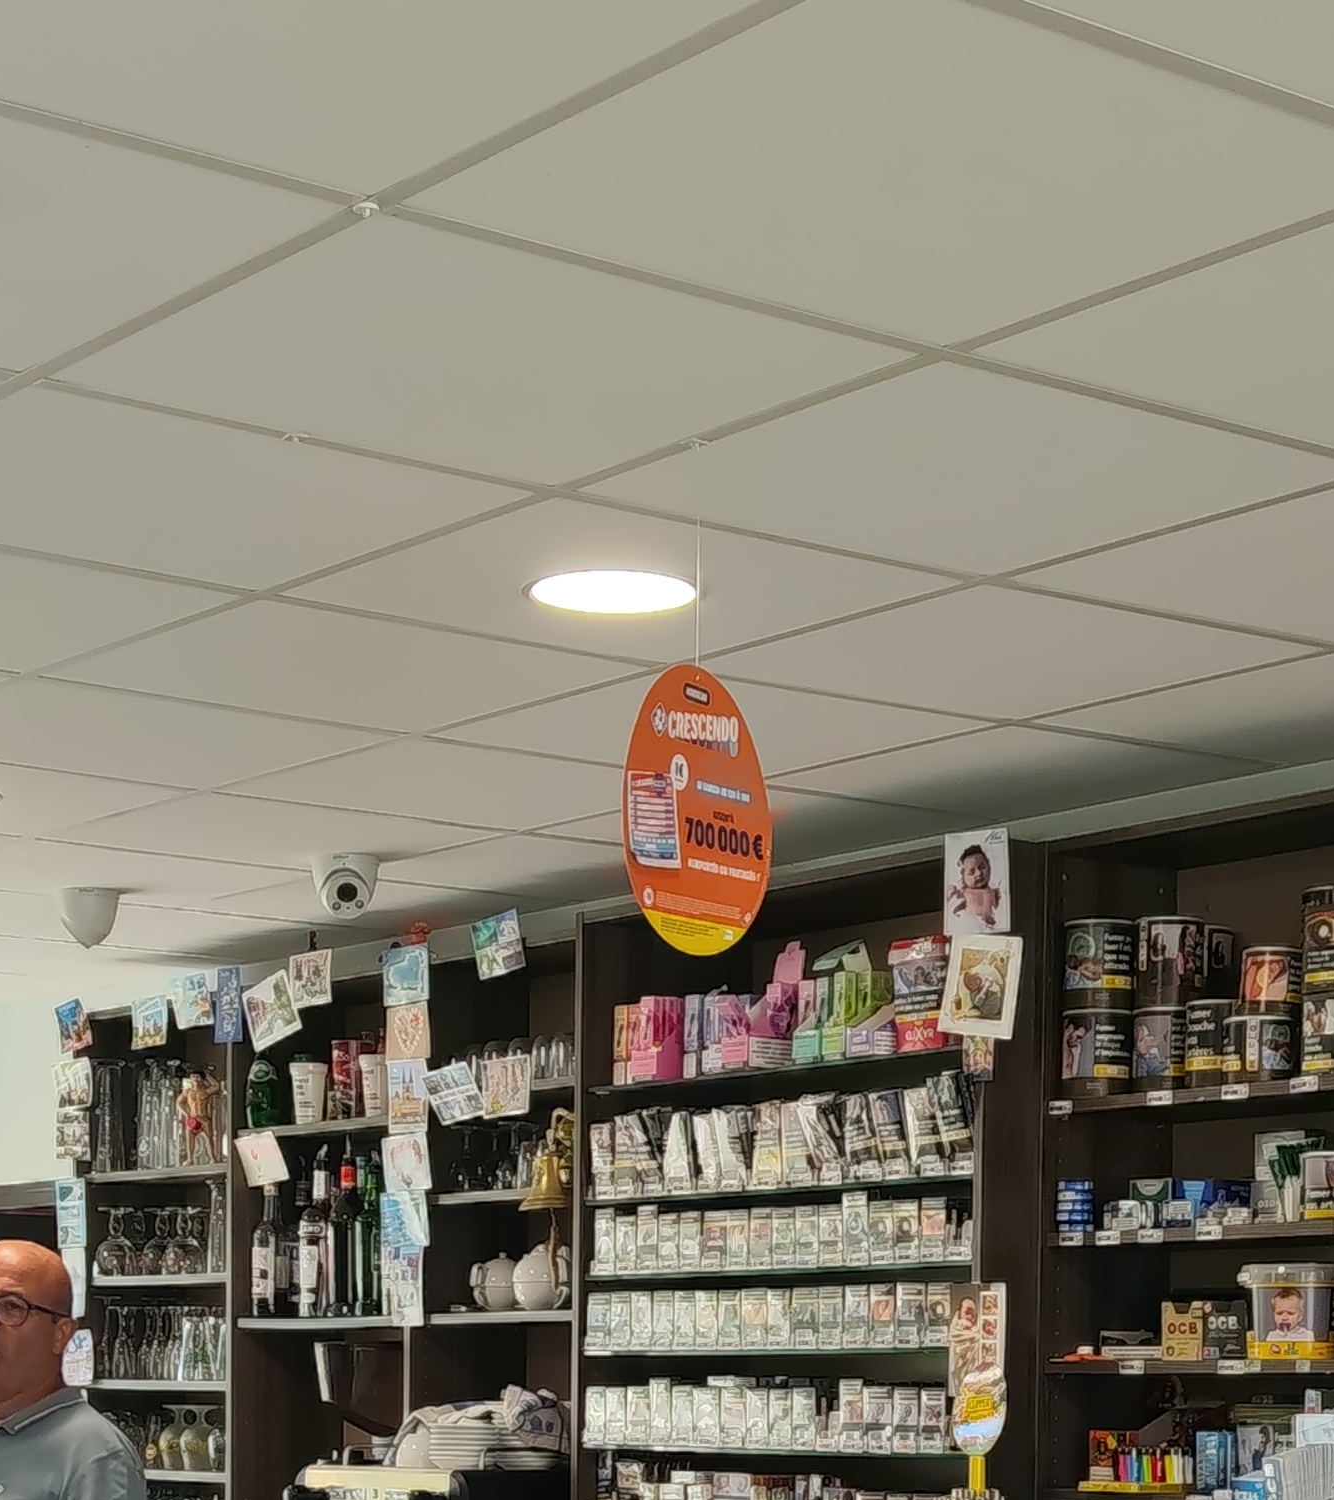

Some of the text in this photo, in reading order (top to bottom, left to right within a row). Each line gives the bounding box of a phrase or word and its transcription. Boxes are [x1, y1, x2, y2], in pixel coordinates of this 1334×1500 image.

[668, 711, 738, 742] CRESCENDO
[685, 816, 715, 849] 700
[718, 825, 750, 857] 000
[1306, 1189, 1330, 1198] Fumer
[1168, 1321, 1198, 1335] OCB
[1207, 1315, 1239, 1330] OCB
